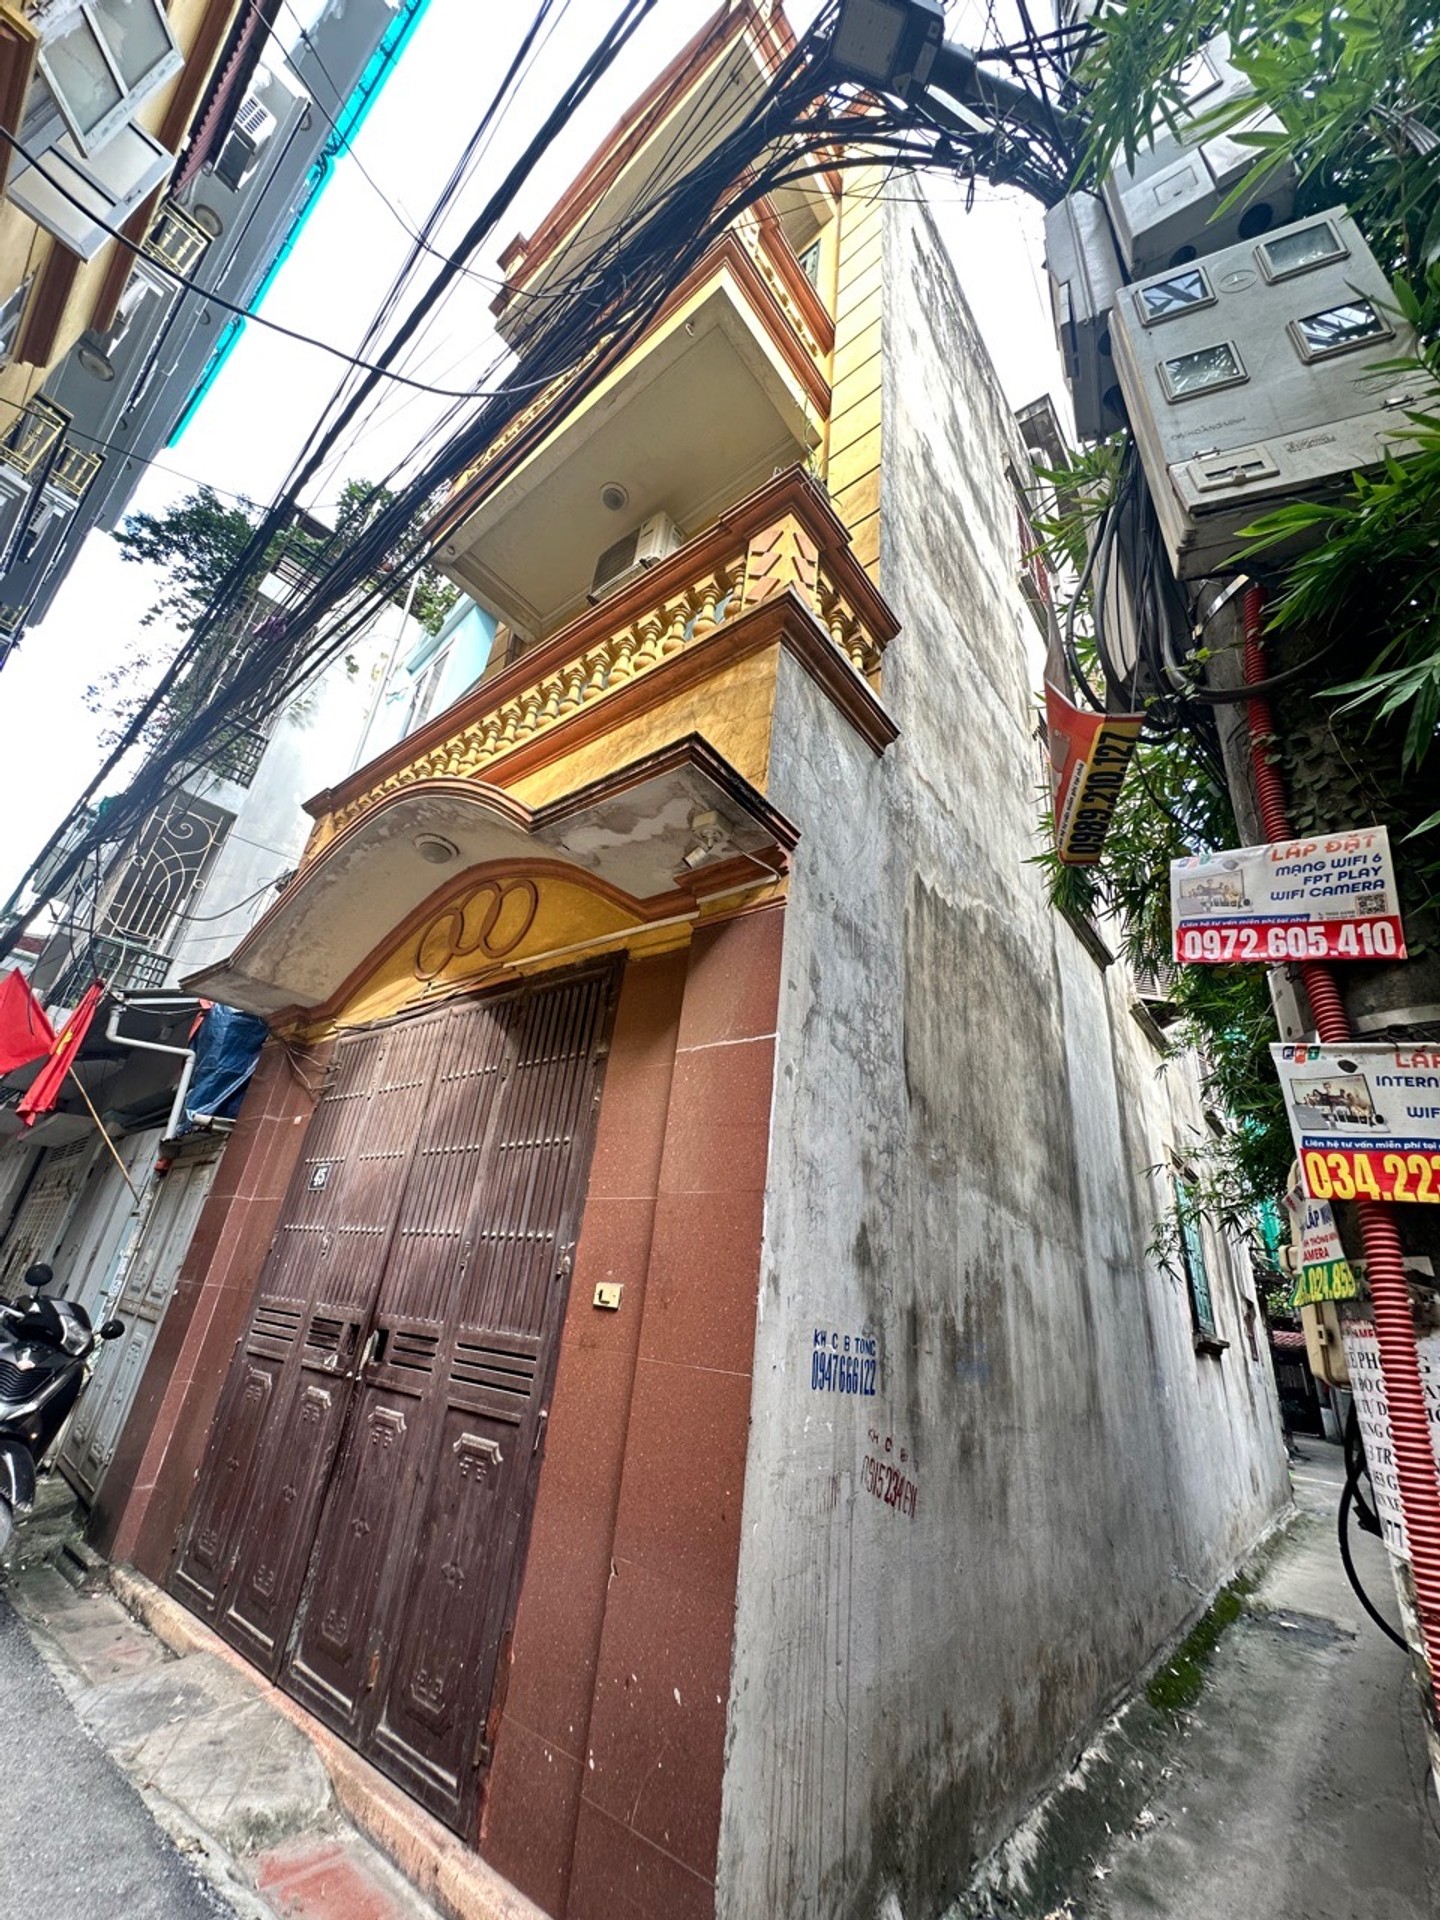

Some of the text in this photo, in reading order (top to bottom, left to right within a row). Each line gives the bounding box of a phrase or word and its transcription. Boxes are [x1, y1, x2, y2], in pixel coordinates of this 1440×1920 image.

[1067, 731, 1136, 853] 0989.210.127
[1275, 853, 1382, 876] MẠNG WIFI 6
[1303, 866, 1383, 885] FPT PLAY
[1270, 879, 1385, 901] WIFI CAMERA
[1184, 921, 1396, 960] 0972.605.410
[1376, 1076, 1440, 1088] INTERN
[1407, 1106, 1440, 1118] WIF
[1304, 1139, 1325, 1147] Liên
[1326, 1140, 1339, 1148] hệ
[812, 1351, 876, 1396] 0947666122
